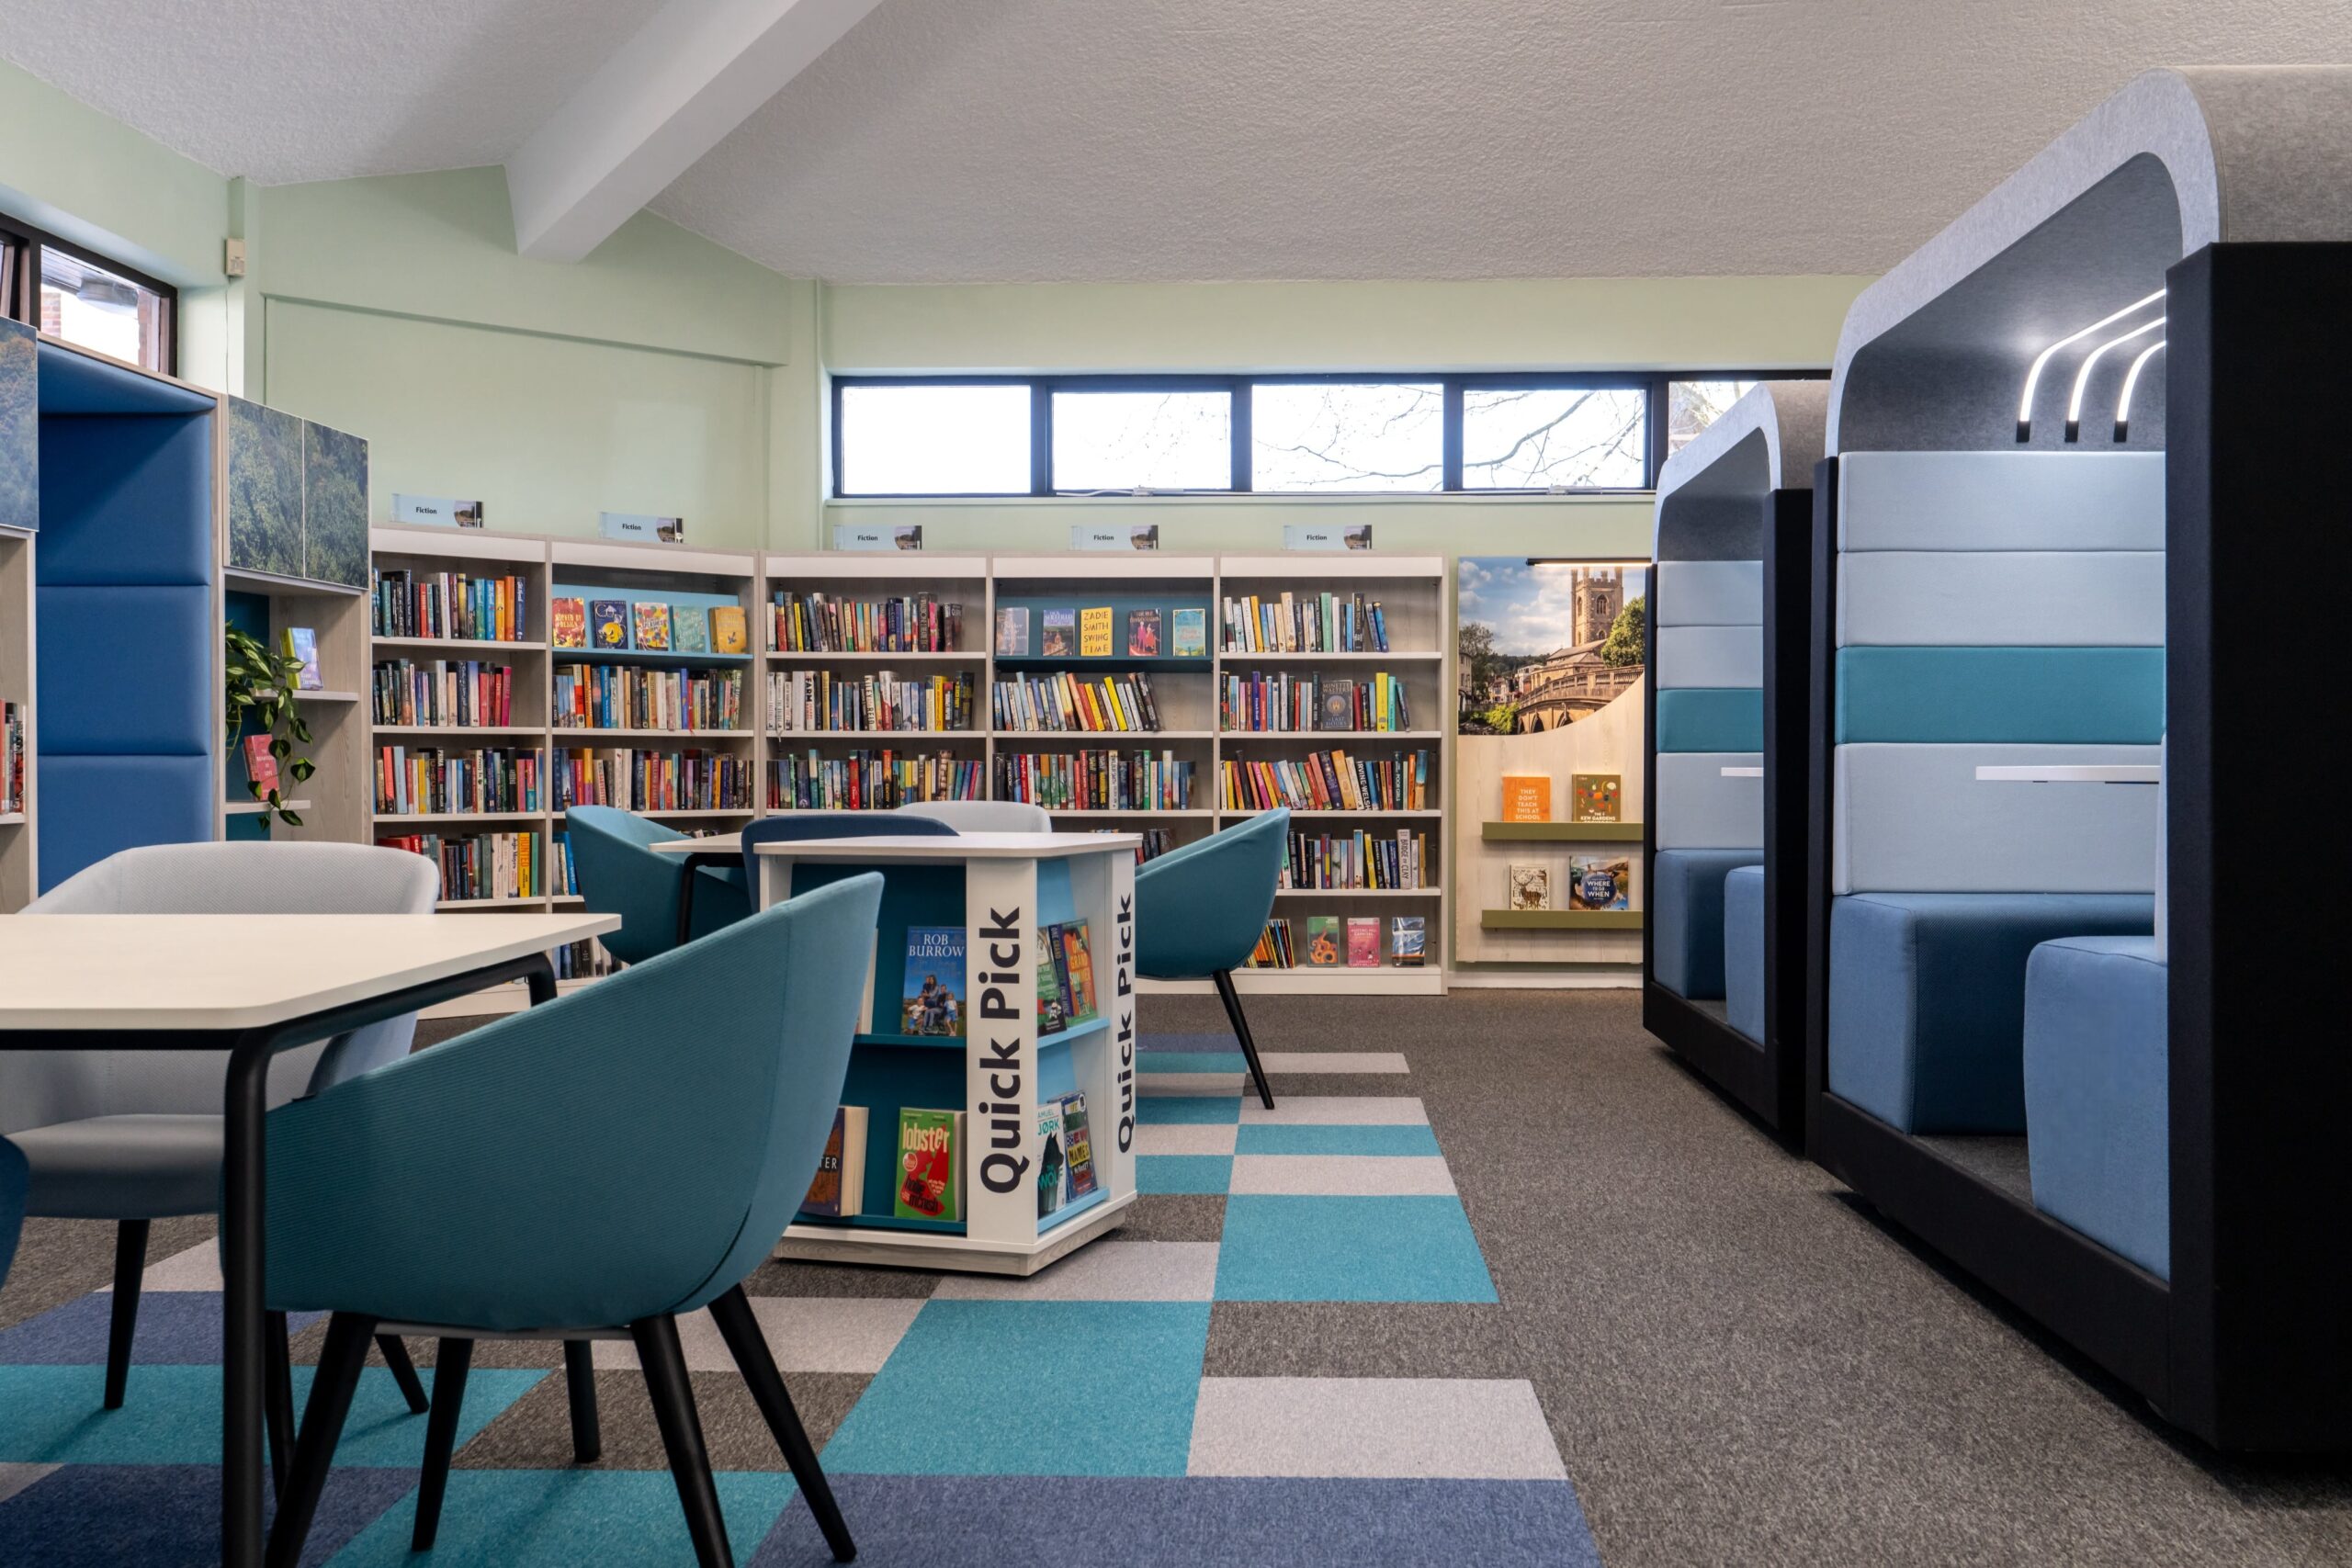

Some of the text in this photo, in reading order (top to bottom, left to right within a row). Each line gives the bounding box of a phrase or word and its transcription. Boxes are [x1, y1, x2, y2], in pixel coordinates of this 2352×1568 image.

[415, 506, 437, 515] Fiction
[622, 523, 642, 531] Fiction
[1083, 611, 1109, 620] ZADIE
[1083, 622, 1109, 631] SMITH
[1083, 633, 1109, 642] SWING
[1084, 645, 1108, 654] TIME
[1357, 761, 1371, 811] IRVINE WELSH
[520, 836, 530, 867] HUNTED
[923, 933, 949, 945] ROB
[909, 945, 965, 957] BURROW
[1072, 939, 1083, 953] ONE
[1069, 953, 1089, 970] GRAND
[1117, 892, 1135, 1154] Quick Pick
[978, 906, 1029, 1194] Quick Pick
[1037, 1109, 1054, 1118] AMUEL
[1038, 1118, 1060, 1136] JØRK
[902, 1122, 950, 1153] lobster
[1069, 1145, 1090, 1164] NAMES
[819, 1156, 837, 1169] TER
[1038, 1168, 1063, 1191] WOLF
